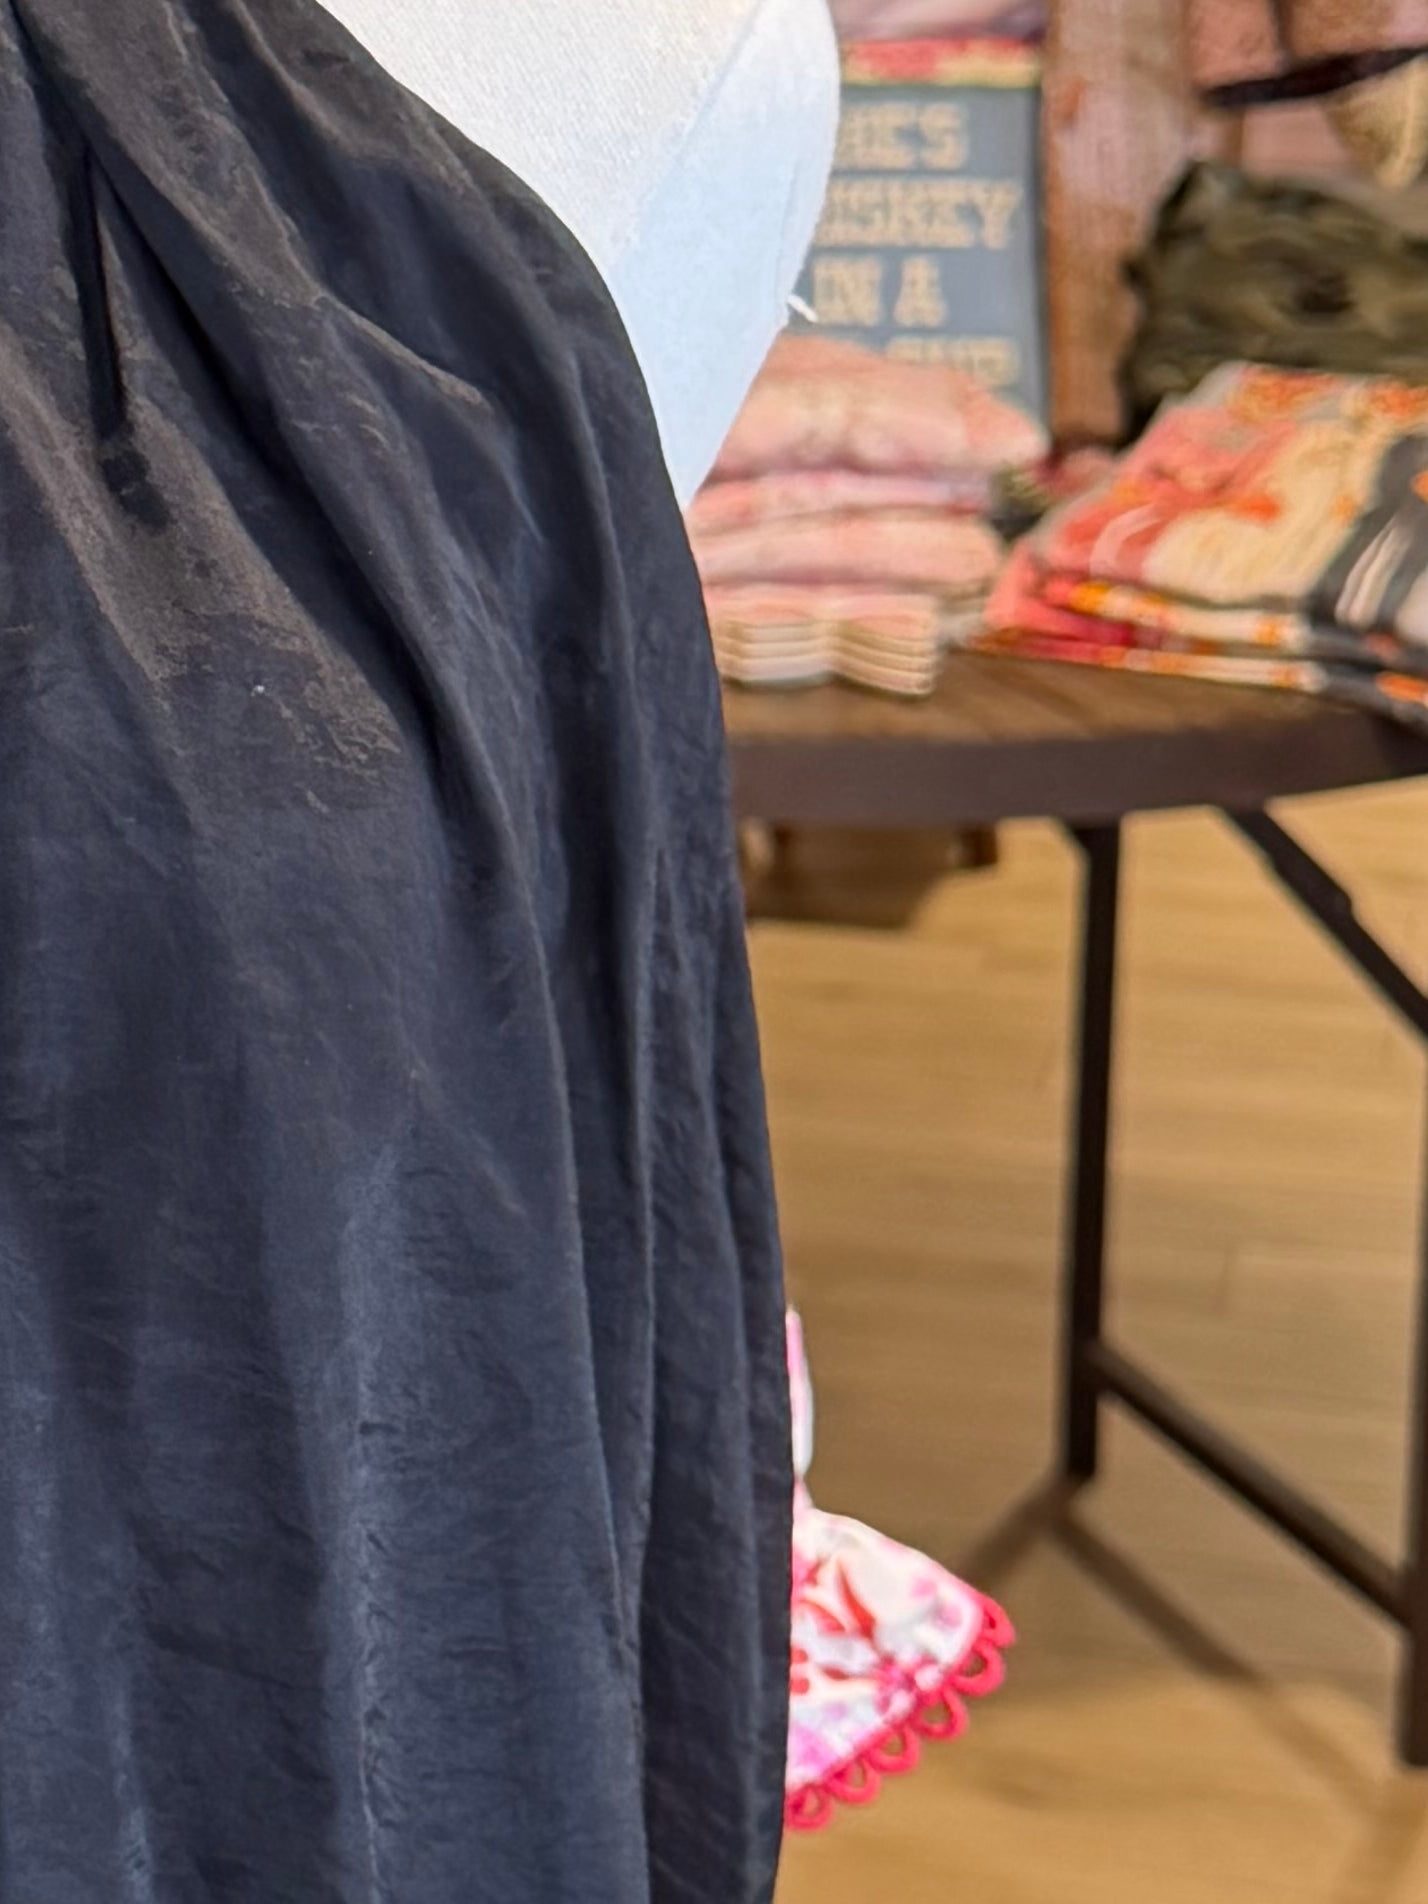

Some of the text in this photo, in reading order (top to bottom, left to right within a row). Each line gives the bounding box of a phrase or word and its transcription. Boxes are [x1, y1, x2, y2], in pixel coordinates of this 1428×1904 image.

[814, 176, 1024, 250] ISKEY
[812, 255, 949, 327] IN A
